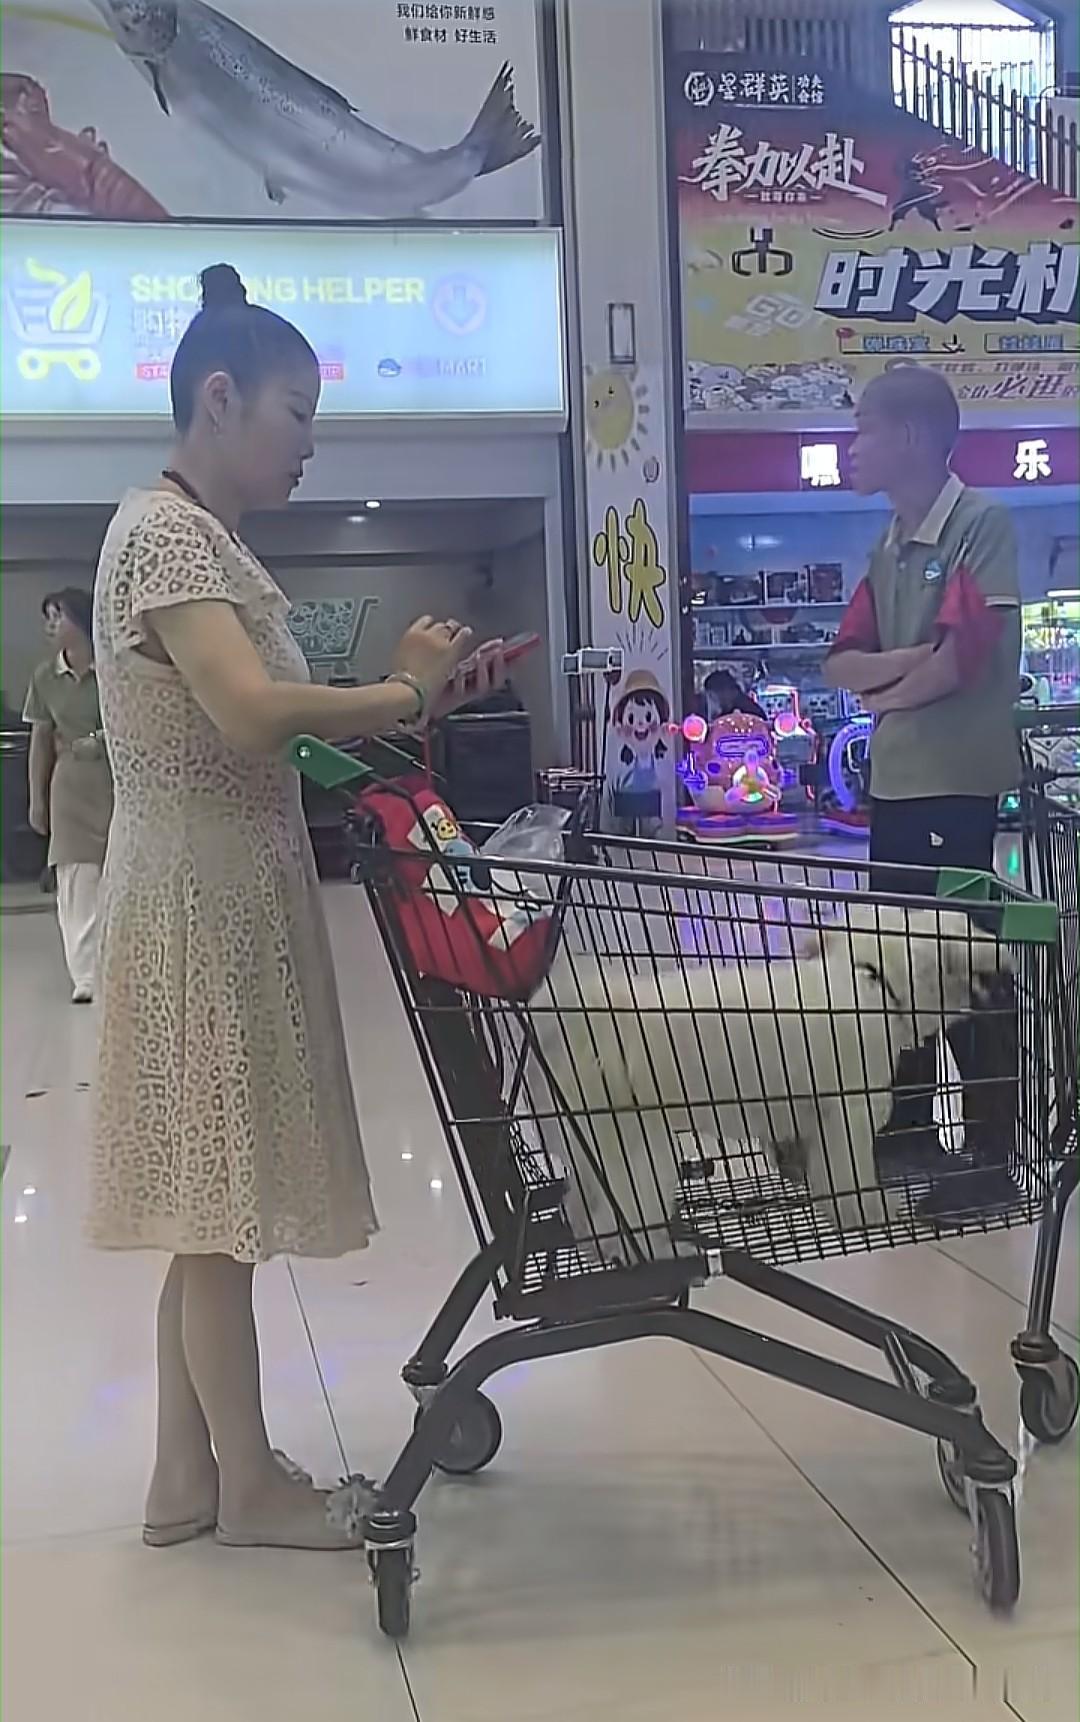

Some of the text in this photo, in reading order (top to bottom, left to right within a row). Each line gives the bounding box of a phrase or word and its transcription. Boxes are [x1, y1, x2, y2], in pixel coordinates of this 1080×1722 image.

[397, 3, 495, 20] 我们给你新鲜感
[405, 27, 496, 44] 鲜食材 好生活
[678, 122, 888, 207] 拳力以赴
[131, 275, 425, 303] SHONG HELPER
[814, 241, 1079, 320] 时光机
[1013, 439, 1052, 481] 乐
[594, 498, 667, 628] 快
